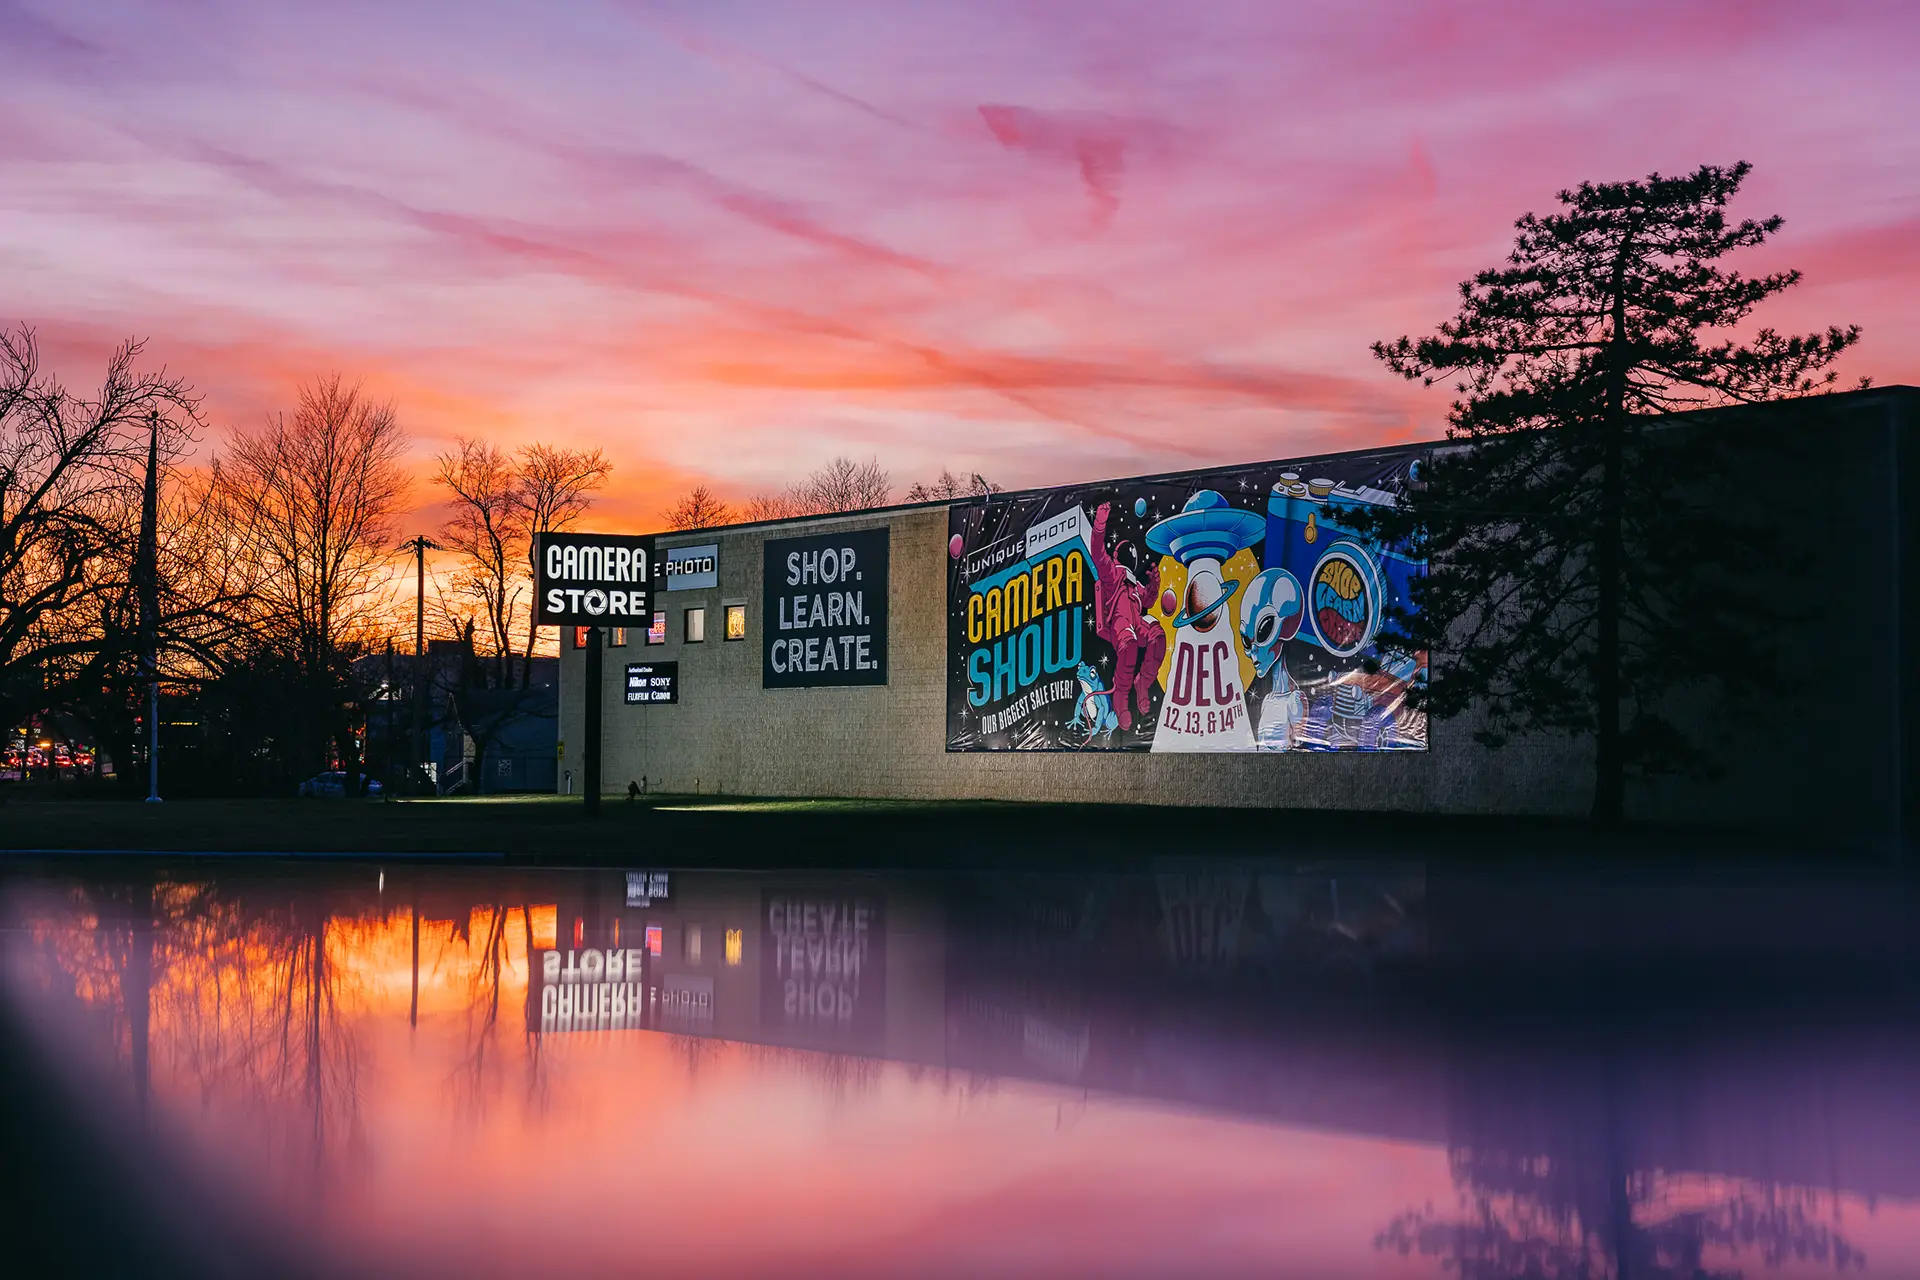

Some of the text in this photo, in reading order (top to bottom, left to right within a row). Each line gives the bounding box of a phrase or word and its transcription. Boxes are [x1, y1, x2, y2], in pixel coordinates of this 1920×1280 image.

[547, 545, 646, 582] CAMERA
[971, 516, 1076, 574] UNIQUE PHOTO
[665, 558, 712, 576] PHOTO
[786, 547, 862, 586] SHOP.
[546, 588, 646, 616] STORE
[779, 591, 870, 630] LEARN.
[967, 551, 1083, 644] CAMERA
[771, 634, 878, 674] CREATE.
[969, 606, 1082, 707] SHOW
[1171, 640, 1241, 706] DEC.
[650, 677, 671, 686] SONY
[651, 690, 671, 700] Canon
[982, 679, 1073, 734] OUR BIGGEST SALE EVER!
[1163, 706, 1181, 734] 12,
[1185, 711, 1204, 737] 13,
[1207, 710, 1217, 734] &
